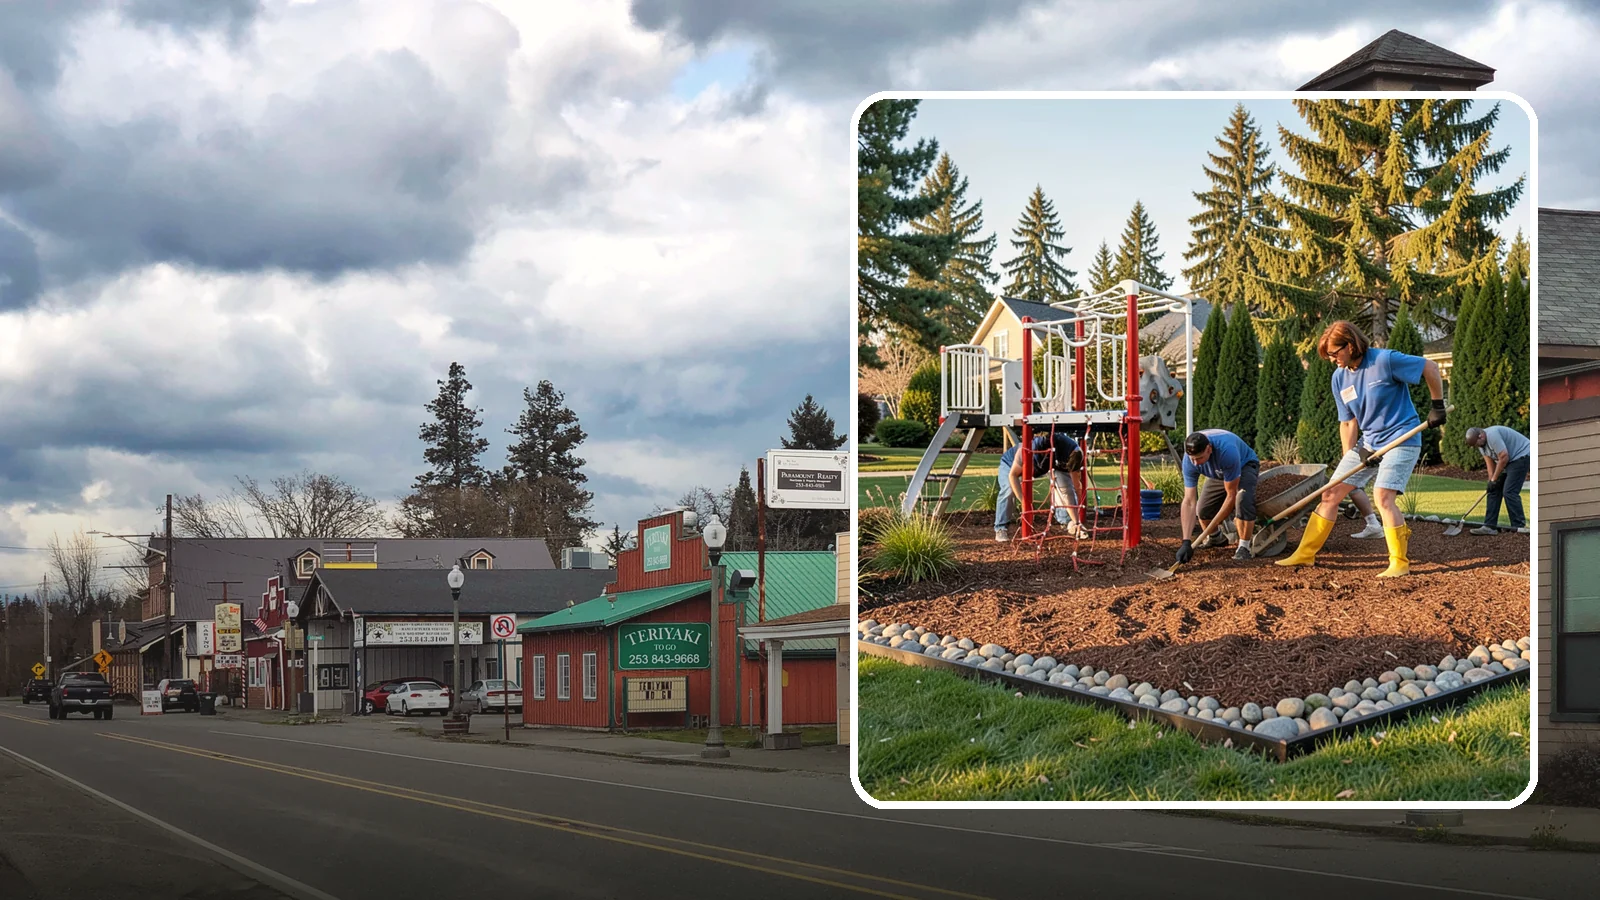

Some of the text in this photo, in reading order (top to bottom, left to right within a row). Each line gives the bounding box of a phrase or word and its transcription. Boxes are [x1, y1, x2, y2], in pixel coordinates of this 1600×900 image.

[625, 627, 703, 646] TERIYAKI
[628, 653, 700, 665] 253 843-9668
[639, 681, 673, 691] TERIYAKI
